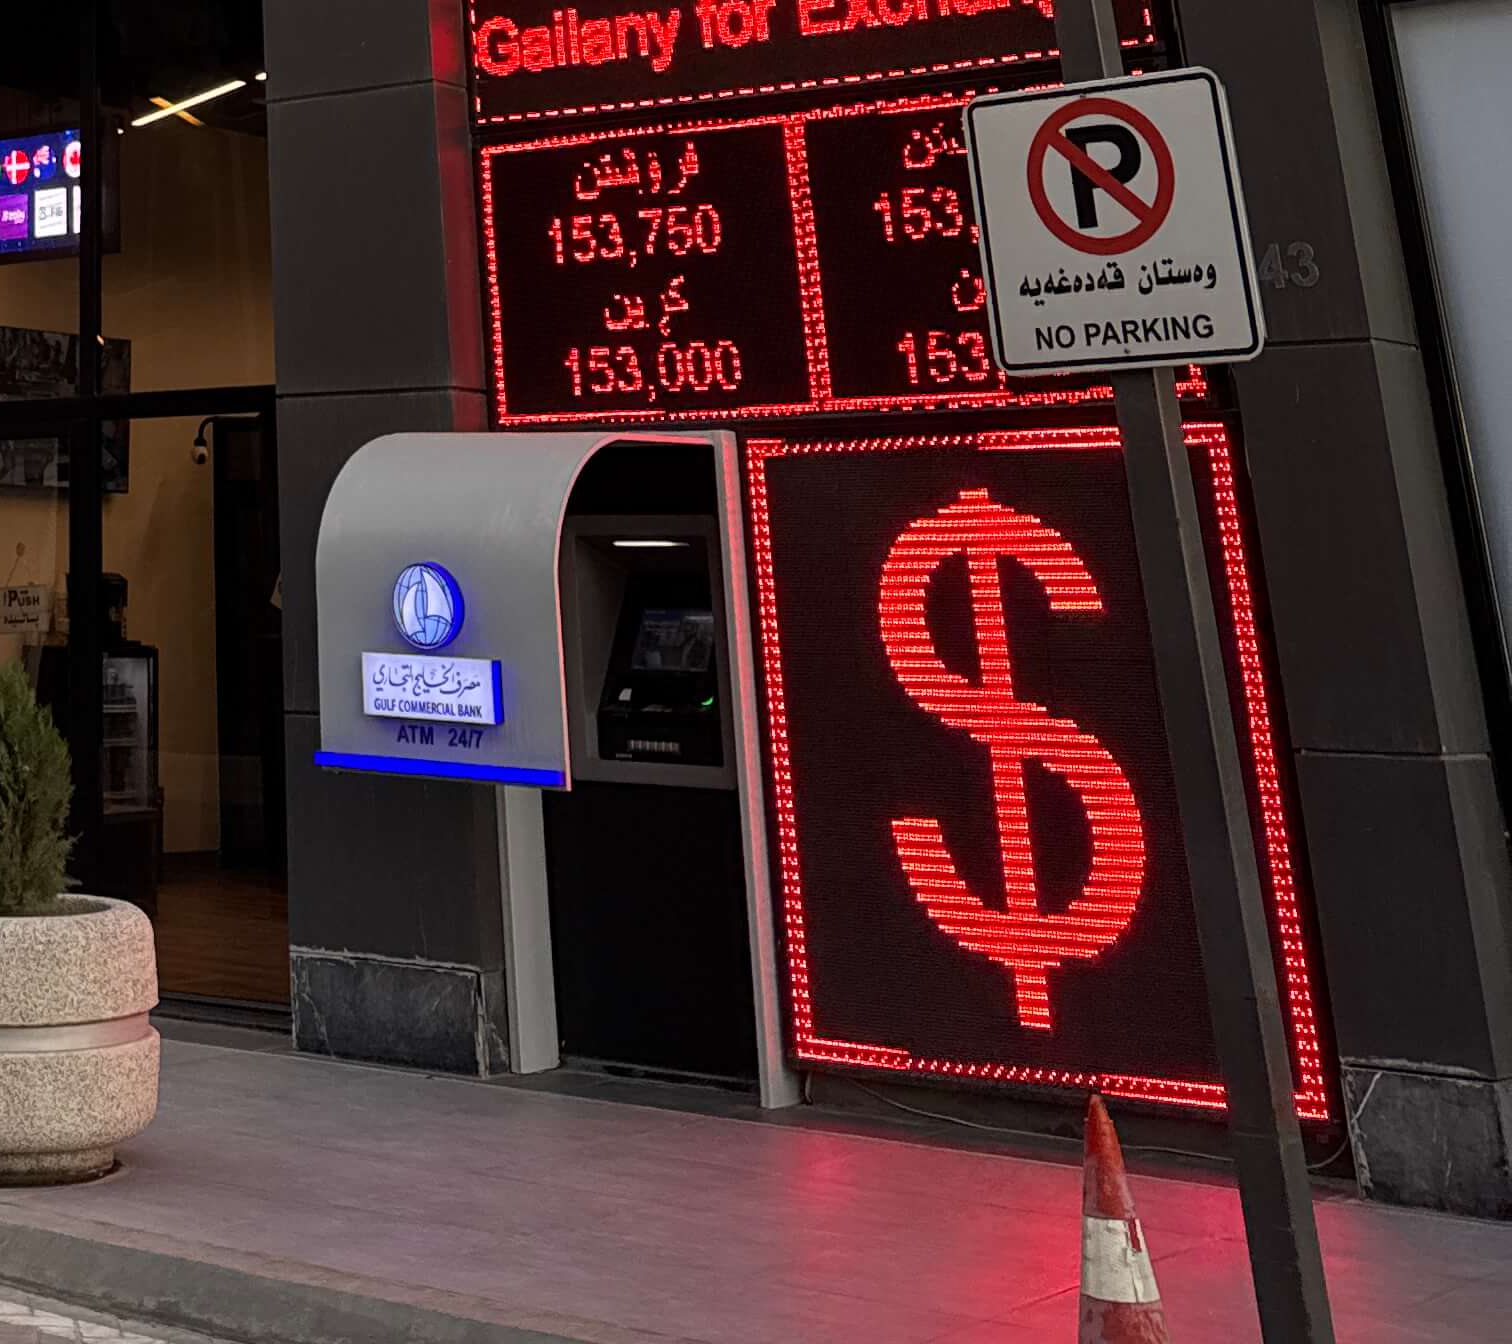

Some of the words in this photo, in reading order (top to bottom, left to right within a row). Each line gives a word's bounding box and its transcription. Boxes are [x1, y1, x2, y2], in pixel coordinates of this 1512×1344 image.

[477, 8, 683, 77] Gailany
[548, 204, 723, 269] 153,750
[874, 186, 983, 245] 153,
[1138, 258, 1218, 295] وەستان
[1259, 240, 1320, 289] 43
[897, 331, 1007, 392] 153,
[1035, 323, 1076, 350] NO
[1084, 314, 1215, 346] PARKING
[564, 341, 743, 403] 153,000
[374, 697, 397, 712] GULF
[398, 699, 456, 717] COMMERCIAL
[457, 704, 482, 719] BANK
[396, 724, 434, 746] ATM
[447, 728, 484, 749] 24/7
[877, 487, 1147, 1033] $
